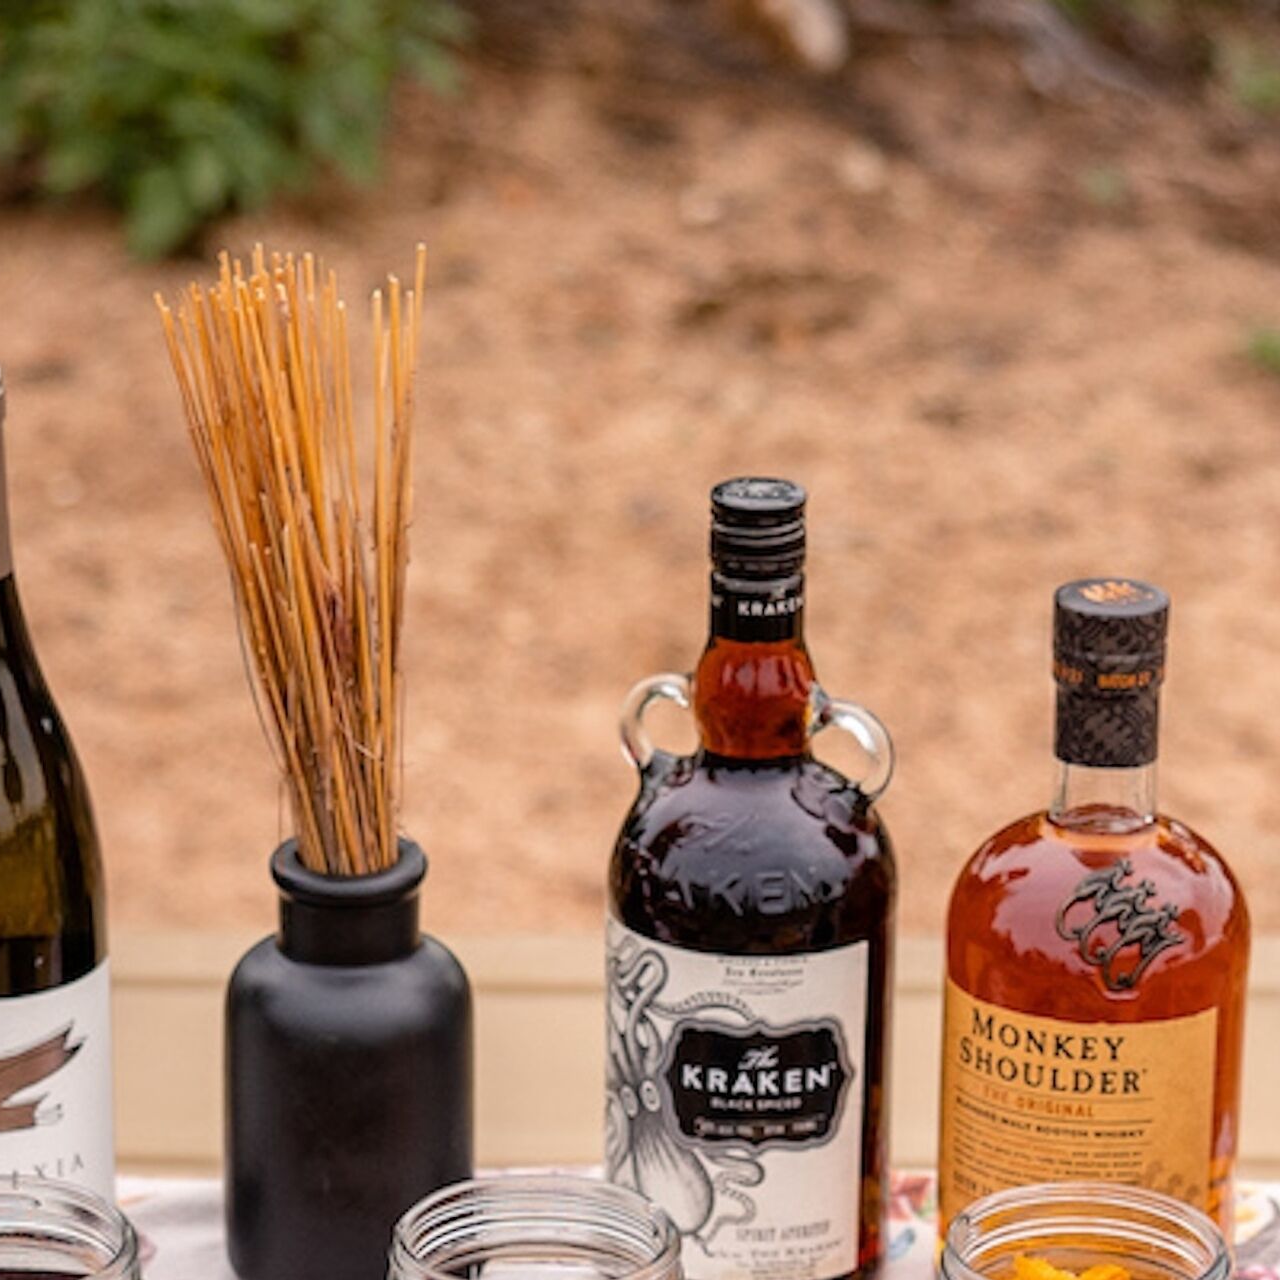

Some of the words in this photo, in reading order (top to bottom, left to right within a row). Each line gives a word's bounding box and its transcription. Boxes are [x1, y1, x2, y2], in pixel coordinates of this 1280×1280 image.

[972, 1007, 1124, 1062] MONKEY
[738, 1045, 779, 1070] The
[959, 1036, 1141, 1095] SHOULDER
[682, 1064, 830, 1096] KRAKEN
[984, 1086, 1009, 1103] THE
[1017, 1096, 1094, 1118] ORIGINAL
